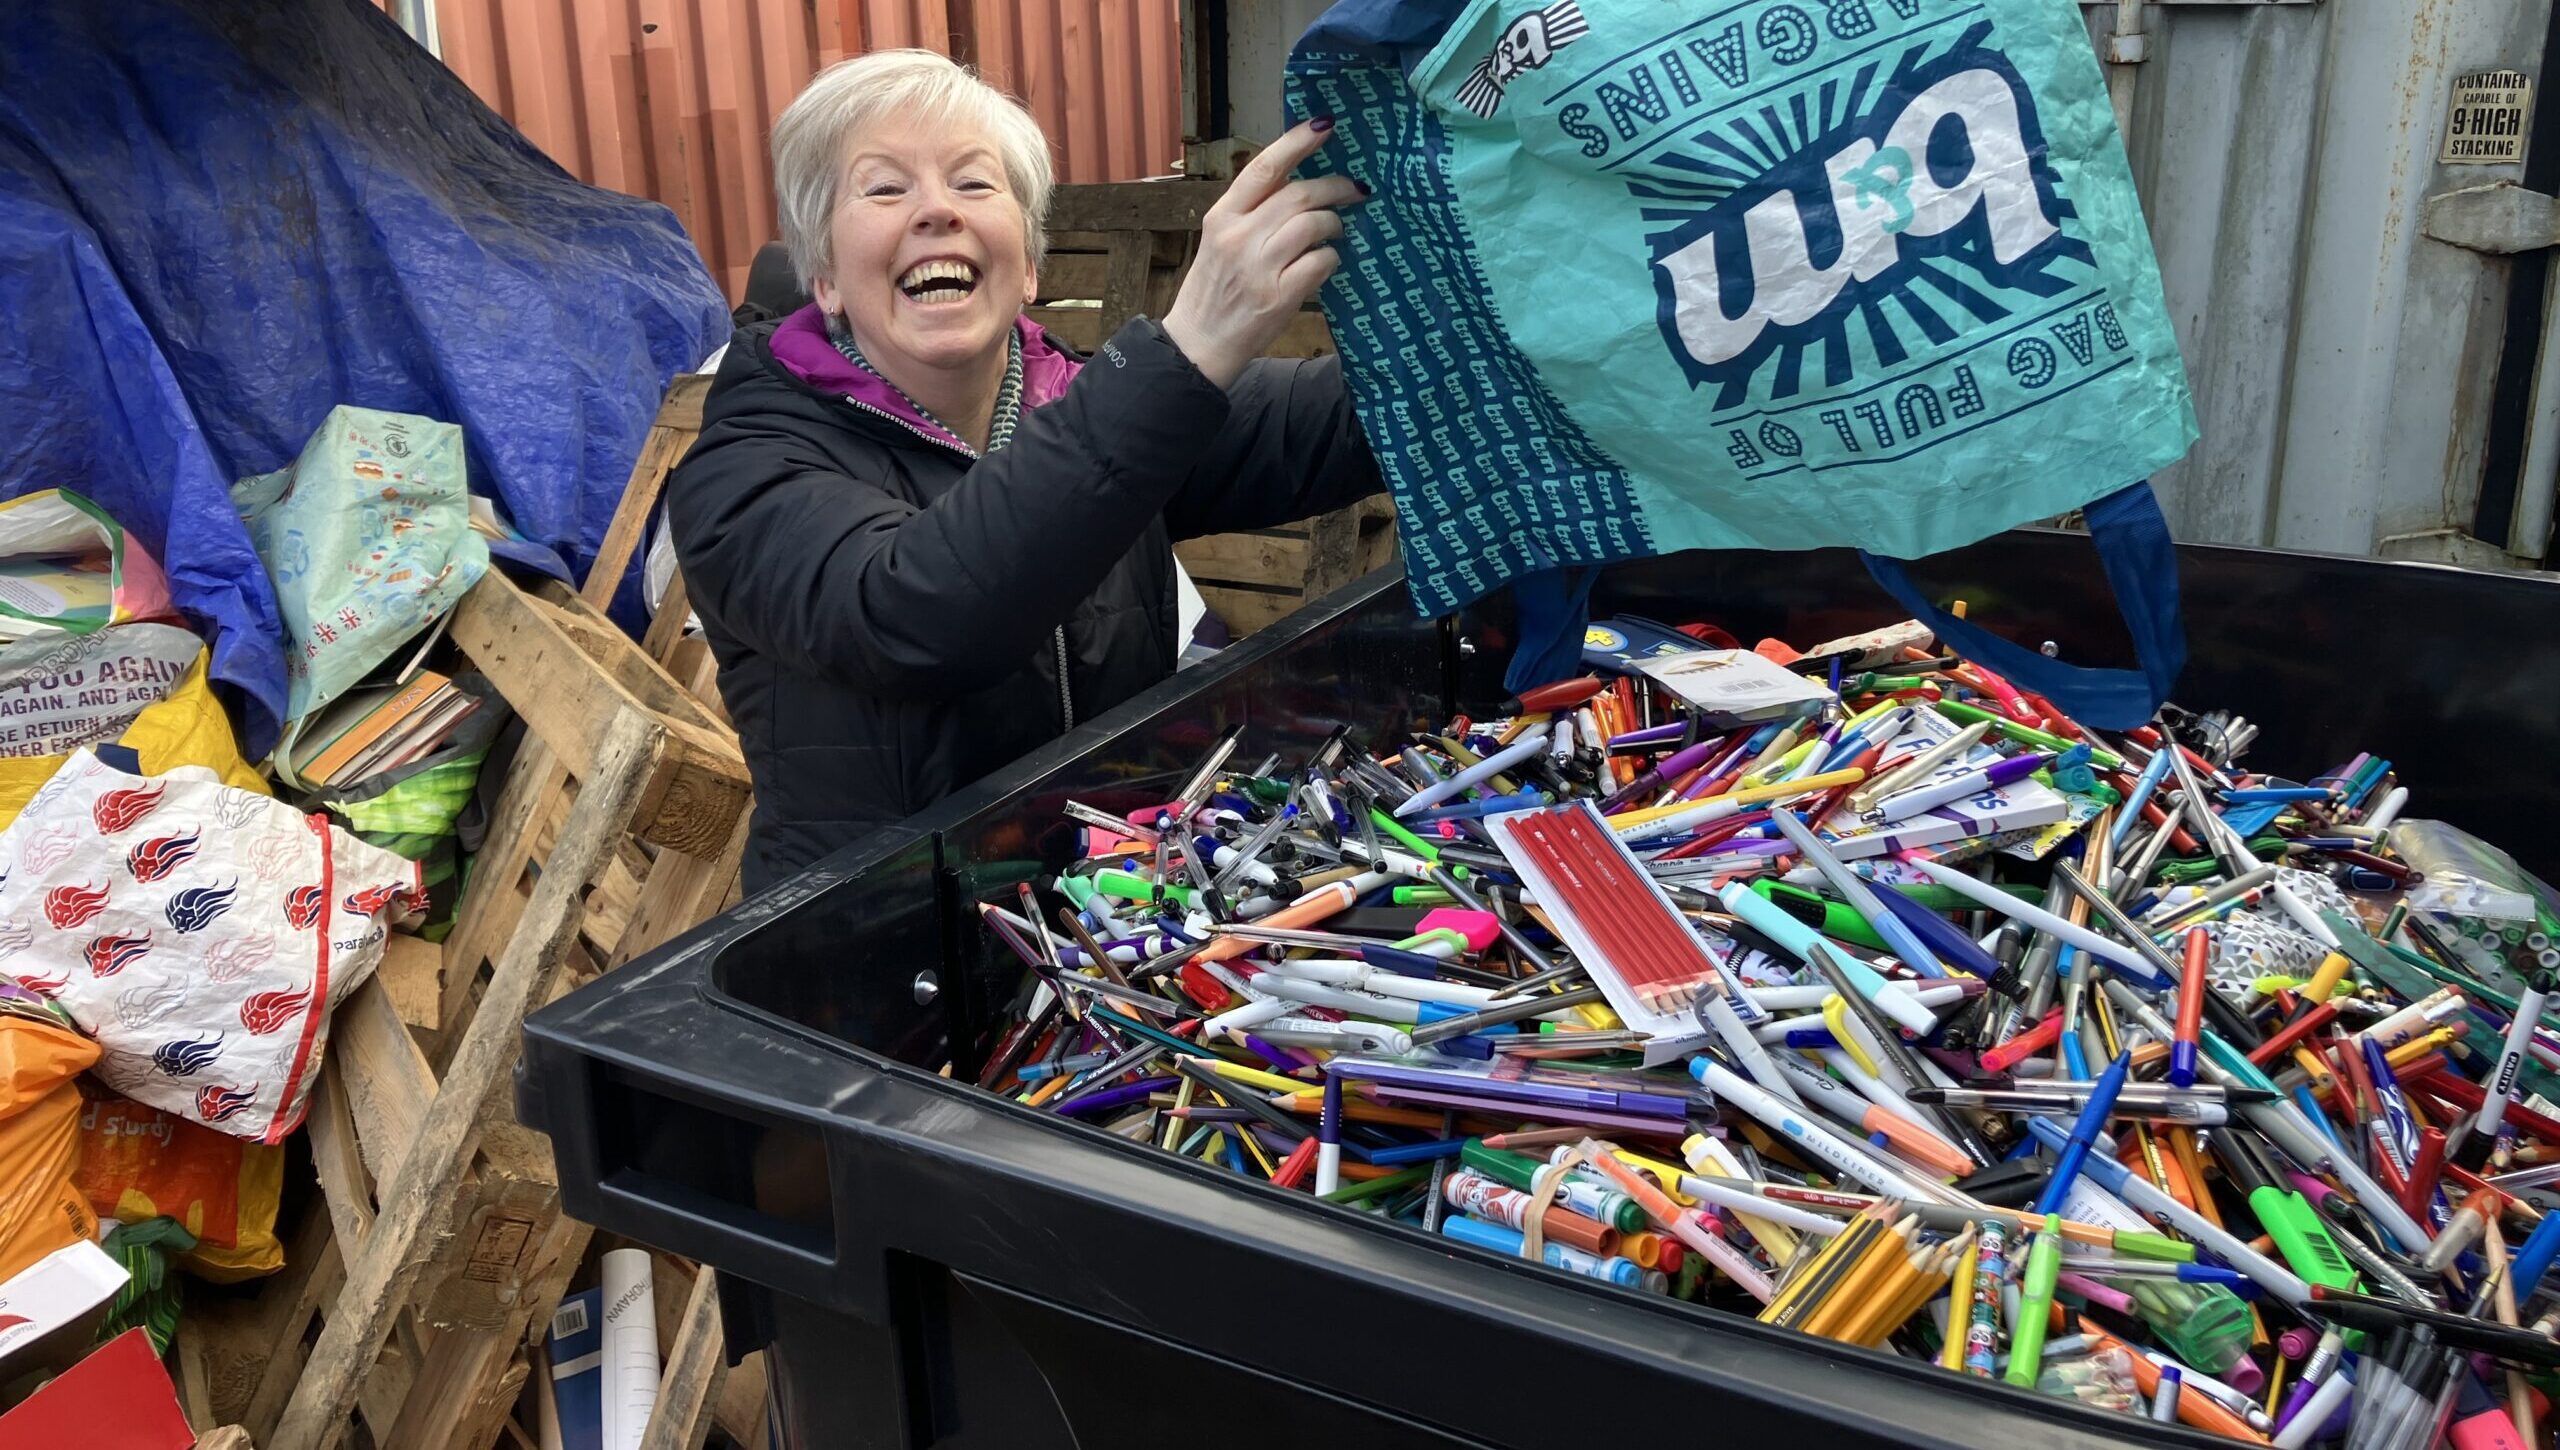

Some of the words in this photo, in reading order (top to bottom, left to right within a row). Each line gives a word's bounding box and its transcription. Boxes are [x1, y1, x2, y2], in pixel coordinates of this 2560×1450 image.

[2458, 73, 2527, 89] CONTAINER
[2464, 93, 2501, 104] CAPABLE
[2506, 93, 2517, 104] OF
[2452, 140, 2514, 155] STACKING
[2007, 301, 2128, 389] BAG
[1820, 364, 1985, 453] FULL
[1727, 420, 1803, 470] OF
[98, 655, 186, 685] AGAIN
[1, 694, 71, 718] AGAIN.
[78, 688, 118, 708] AND
[25, 716, 100, 740] RETURN
[2497, 1052, 2519, 1094] PARITY
[104, 1111, 174, 1148] sturdy
